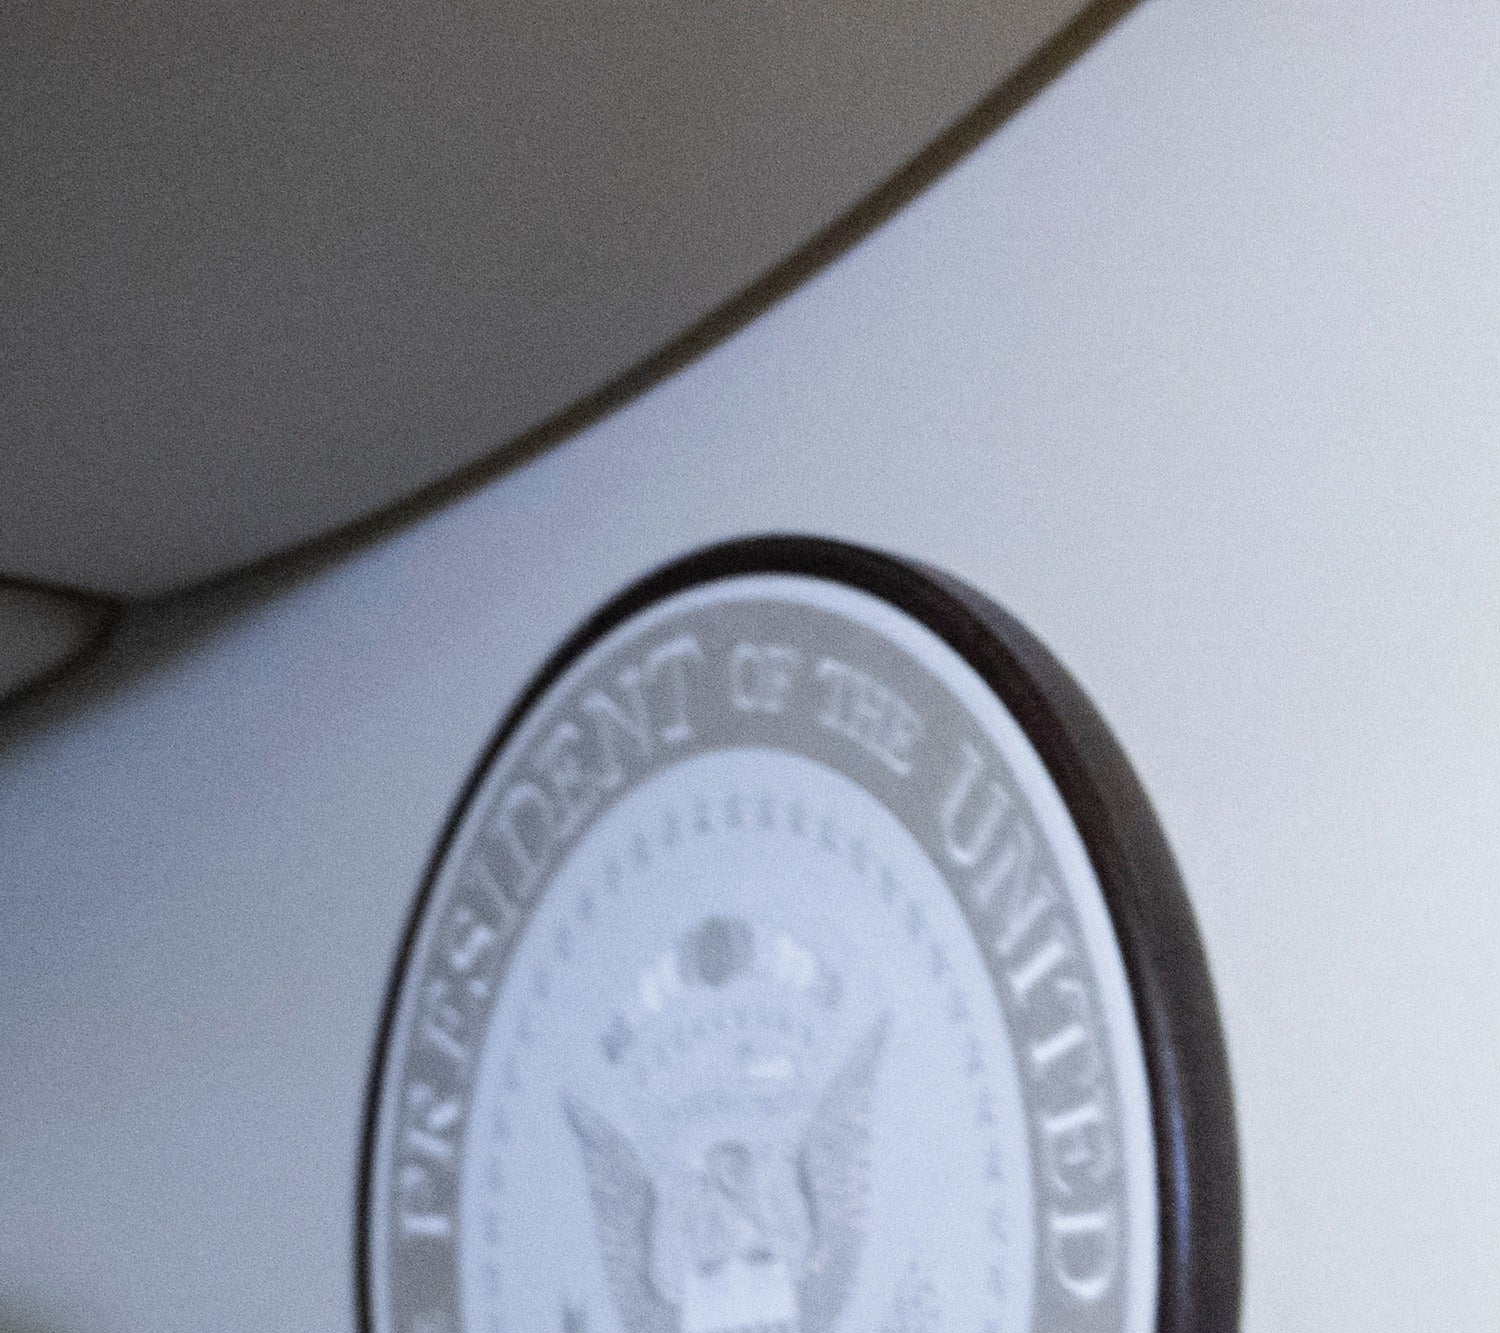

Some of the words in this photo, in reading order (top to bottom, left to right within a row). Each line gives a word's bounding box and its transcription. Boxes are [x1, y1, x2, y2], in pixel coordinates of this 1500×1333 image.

[402, 635, 698, 1236] PRESIDENT
[730, 641, 796, 716] OF
[813, 657, 924, 777] THE
[940, 739, 1118, 1300] UNITED
